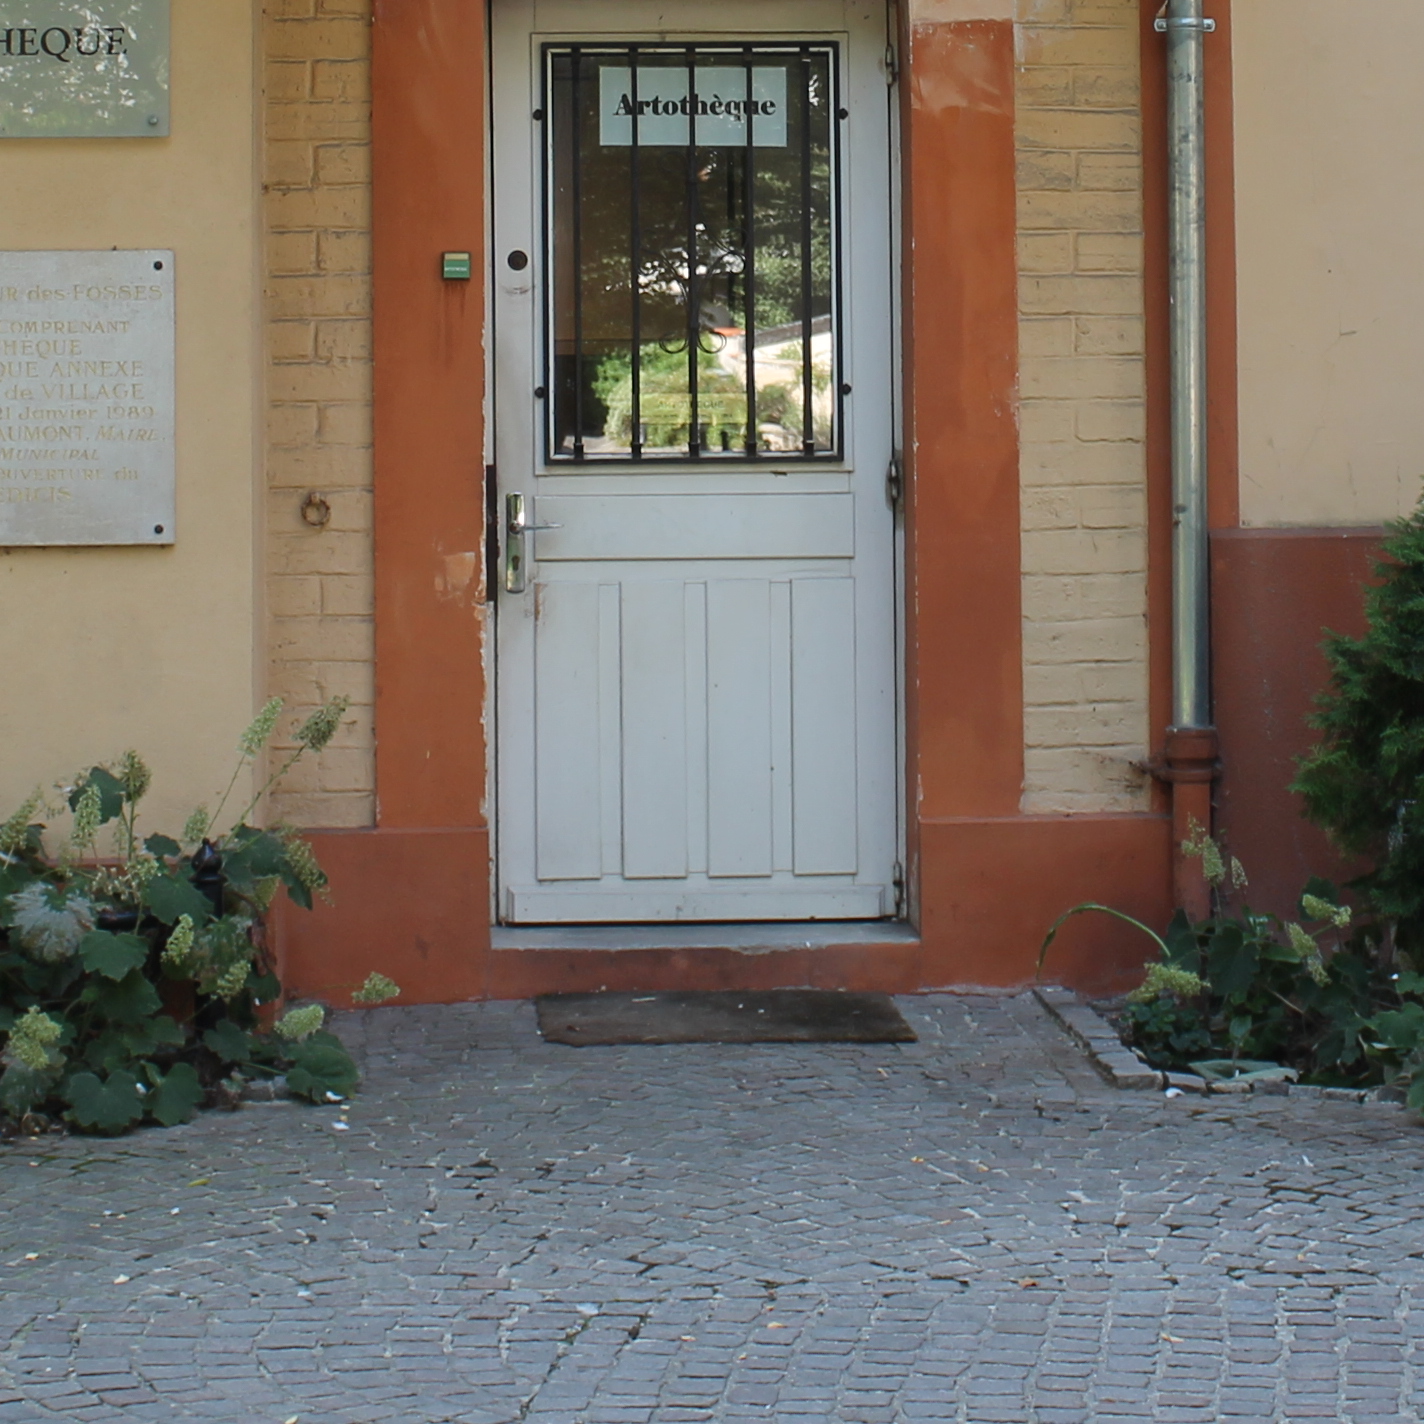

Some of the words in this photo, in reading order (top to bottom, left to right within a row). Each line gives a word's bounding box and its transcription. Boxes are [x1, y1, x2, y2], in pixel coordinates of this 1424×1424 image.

[612, 92, 776, 122] Artothèque
[49, 360, 144, 378] ANNEXE
[4, 384, 34, 401] de
[41, 383, 145, 401] VILLAGE
[18, 404, 99, 421] Janvier
[106, 405, 156, 420] 1989
[112, 466, 140, 481] du
